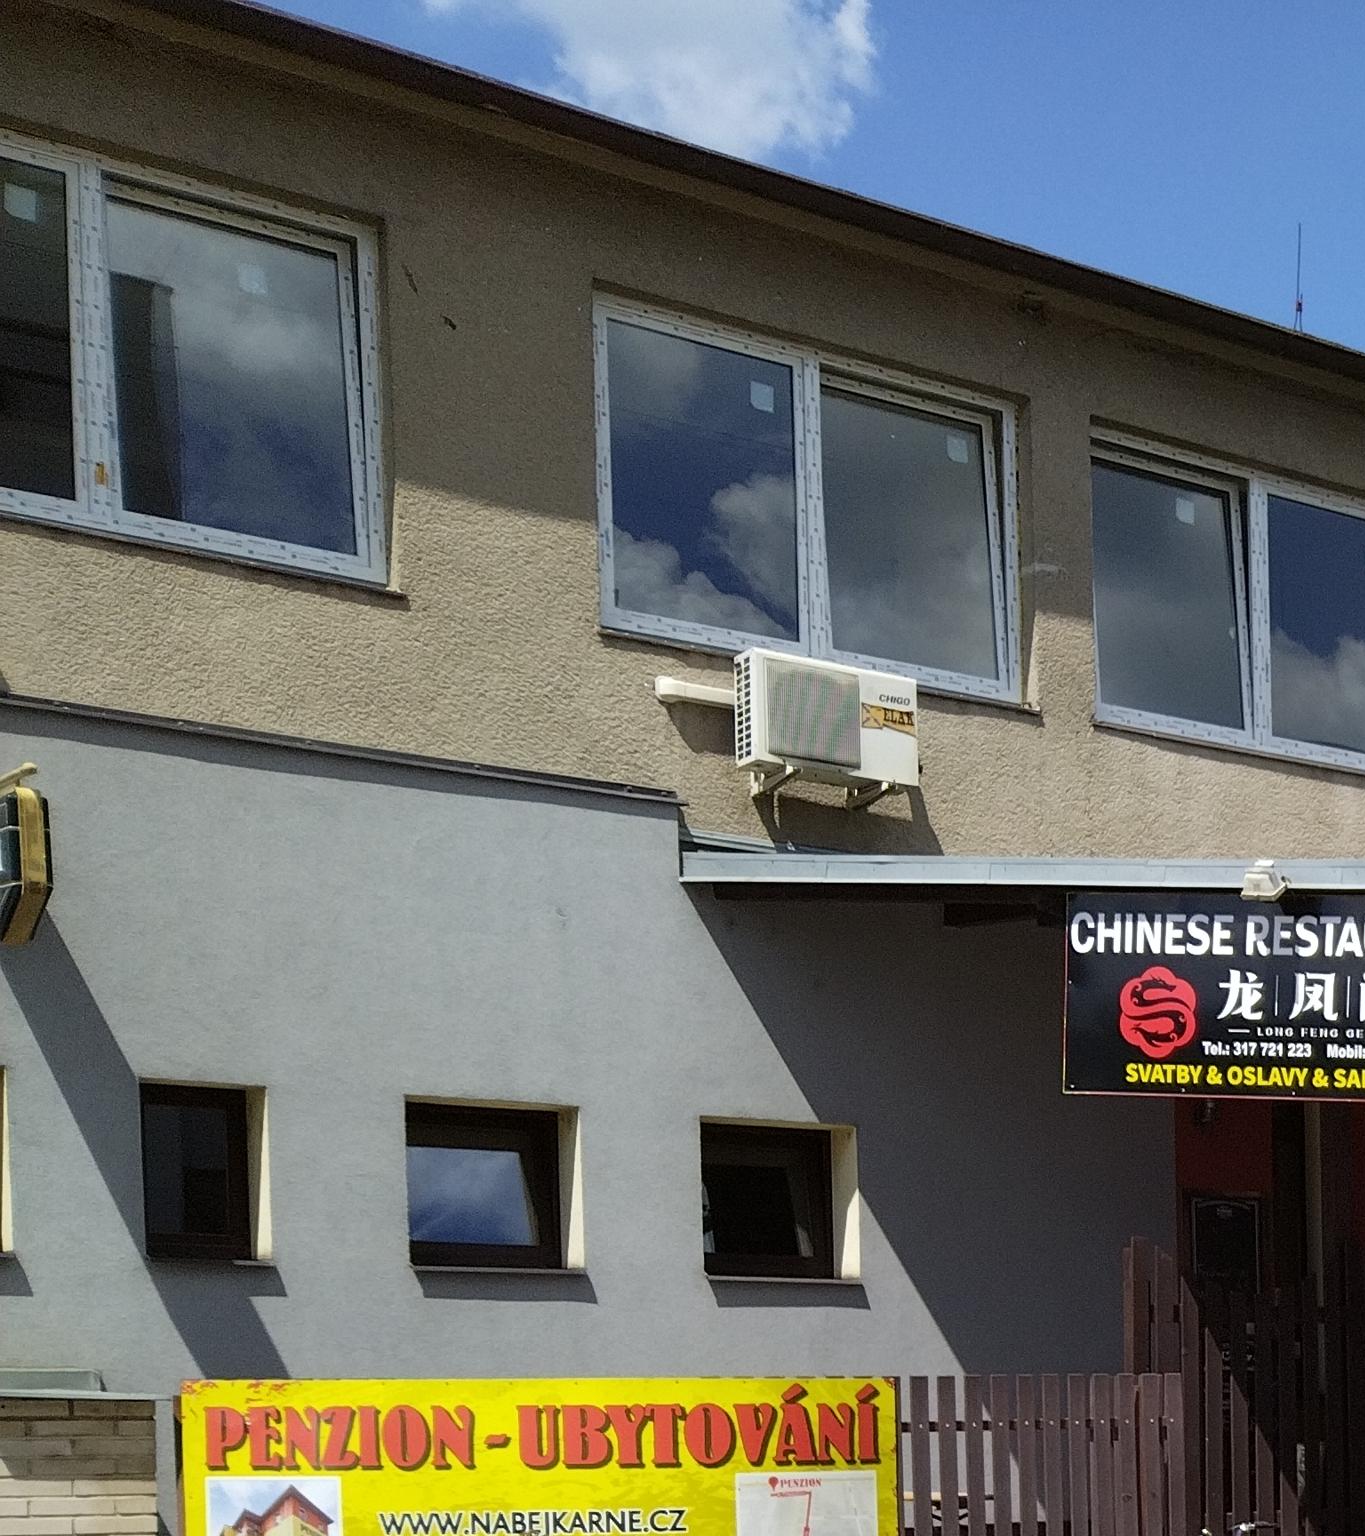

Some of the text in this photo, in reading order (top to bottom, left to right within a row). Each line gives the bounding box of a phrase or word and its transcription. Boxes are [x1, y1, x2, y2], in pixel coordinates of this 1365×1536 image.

[879, 694, 911, 706] CHIGO
[1070, 911, 1234, 957] CHINESE
[1257, 1028, 1365, 1039] LONG FENG GE
[1202, 1041, 1230, 1056] Tel.:
[1233, 1042, 1257, 1057] 317
[1260, 1042, 1284, 1057] 721
[1287, 1043, 1312, 1058] 223
[1125, 1063, 1202, 1085] SVATBY
[1206, 1066, 1222, 1085] &
[1226, 1066, 1308, 1087] OSLAVY
[1312, 1069, 1329, 1088] &
[205, 1403, 476, 1472] PENZION
[518, 1383, 881, 1469] UBYTOVÁNÍ
[379, 1509, 688, 1536] WWW.NABEJKARNE.CZ
